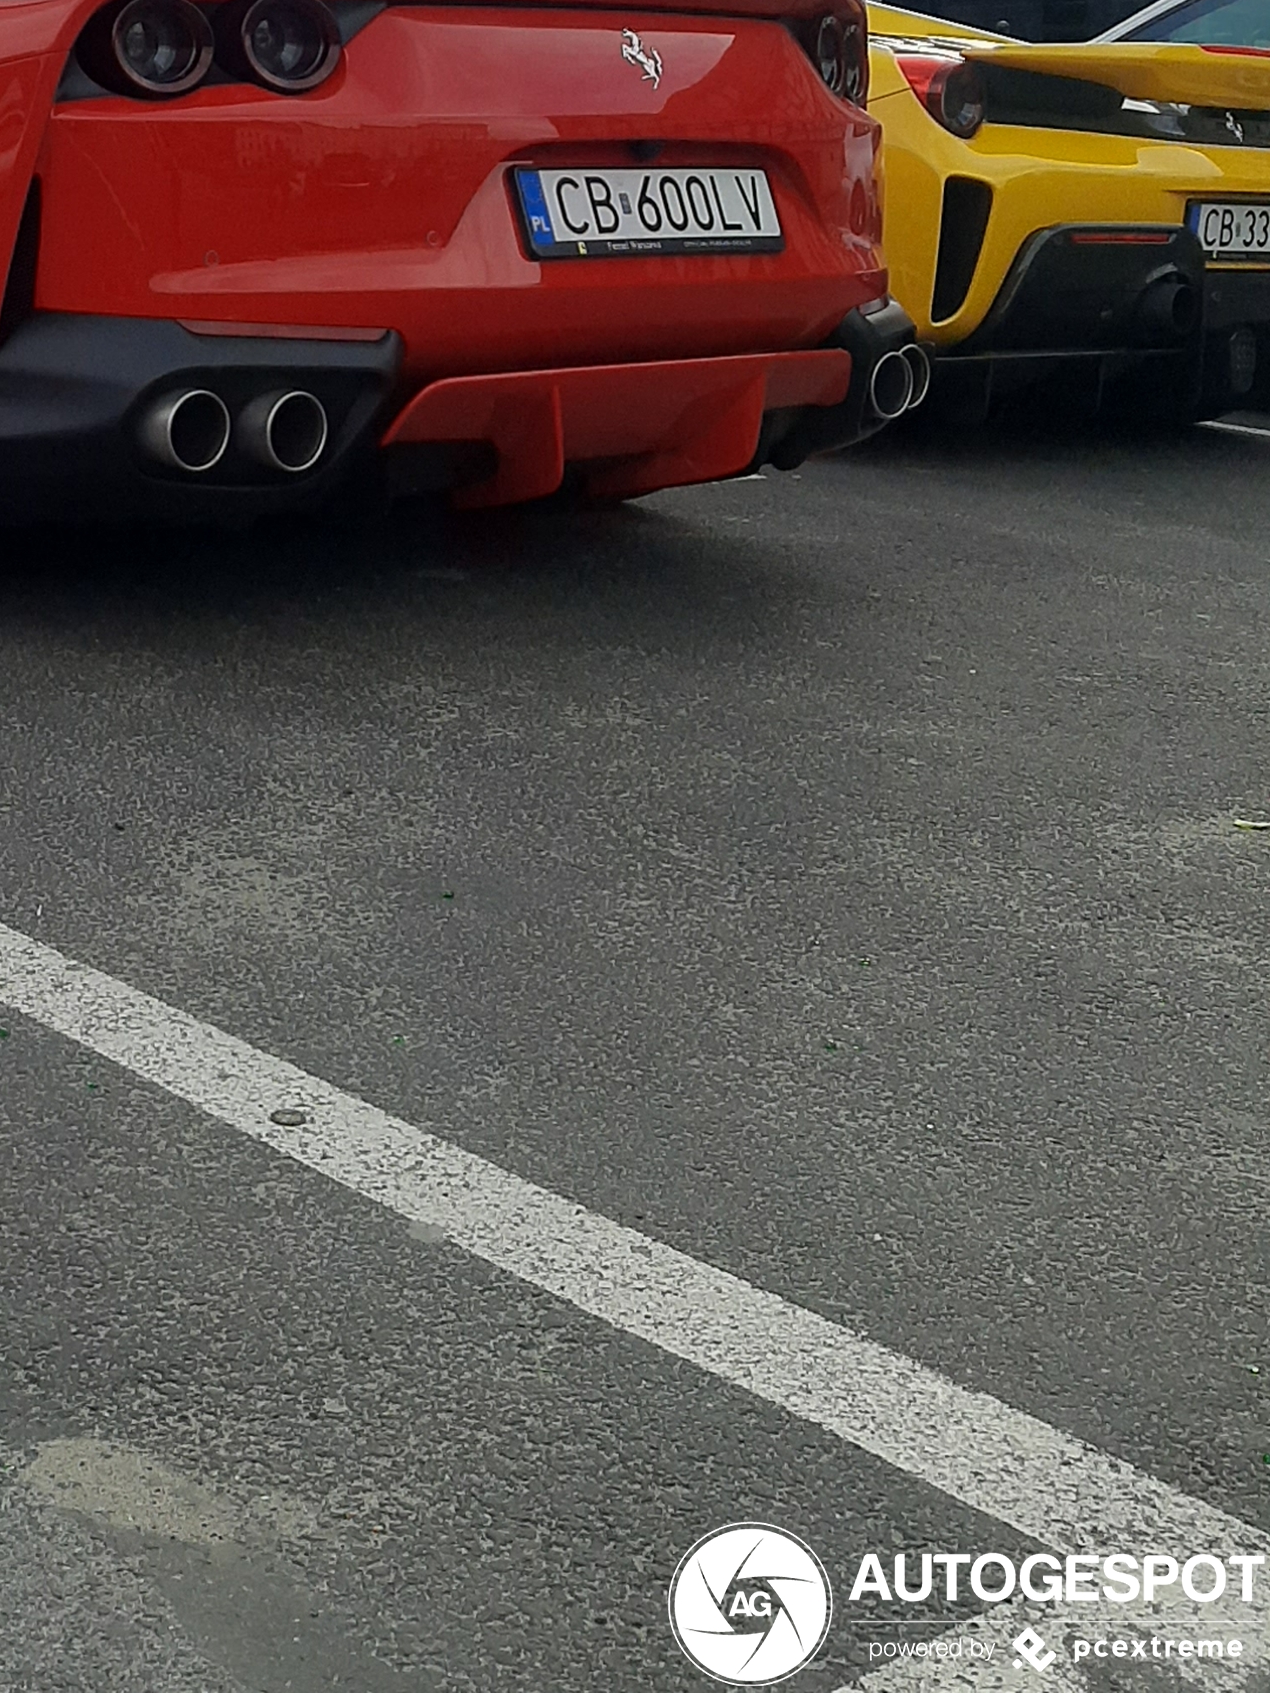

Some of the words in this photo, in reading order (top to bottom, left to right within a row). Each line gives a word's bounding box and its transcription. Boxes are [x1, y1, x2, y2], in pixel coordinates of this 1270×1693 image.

[555, 176, 620, 234] CB
[637, 175, 762, 233] 600LV
[533, 217, 551, 233] PL
[1203, 209, 1234, 247] CB
[1243, 210, 1270, 247] 33
